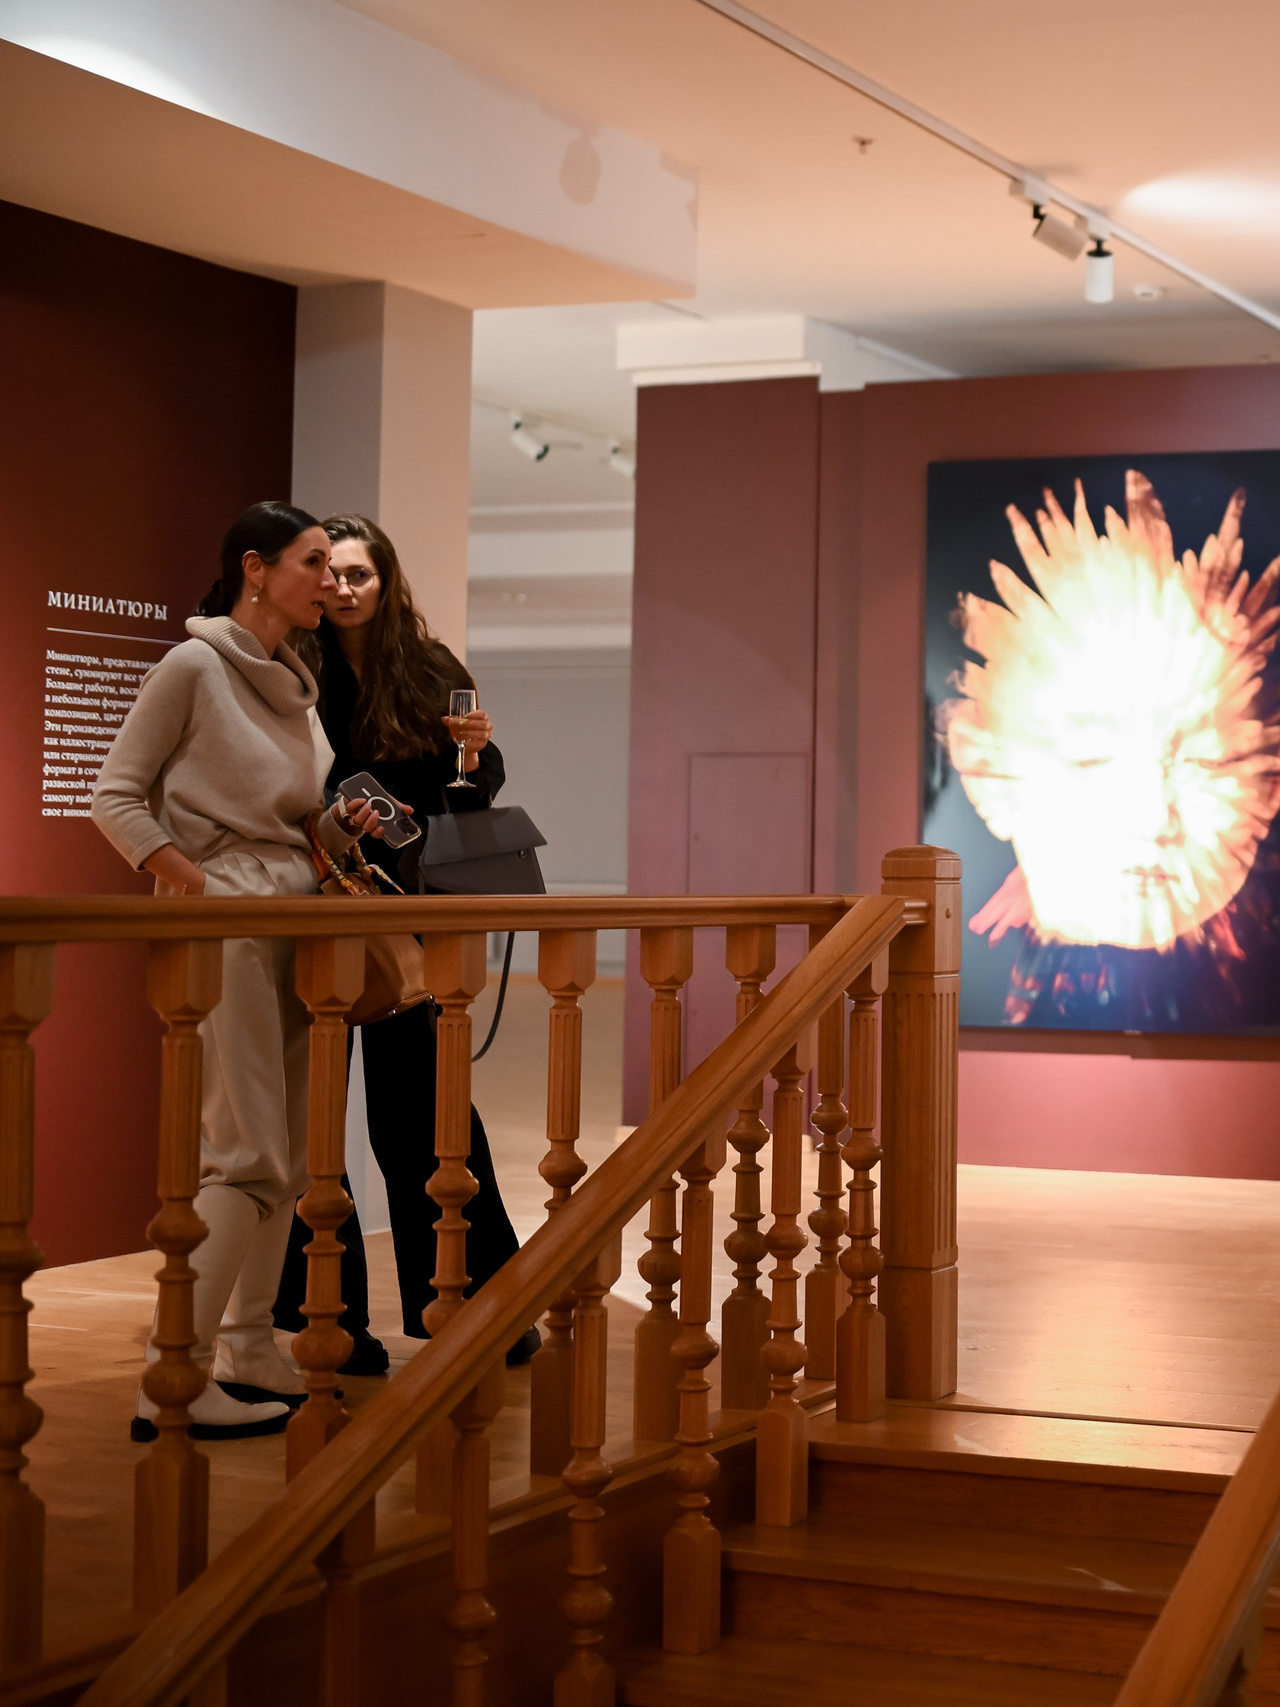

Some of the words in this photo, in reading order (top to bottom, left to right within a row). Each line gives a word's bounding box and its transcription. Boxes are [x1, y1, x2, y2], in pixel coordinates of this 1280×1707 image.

[47, 590, 168, 621] МИНИАТЮРЫ
[46, 649, 102, 667] Миниатюры,
[45, 665, 73, 677] стене,
[46, 678, 84, 691] Большие
[84, 683, 118, 694] работы,
[52, 694, 101, 706] небольшом
[44, 708, 103, 721] композицию,
[103, 712, 124, 723] цвет
[44, 720, 61, 731] Эти
[43, 737, 59, 746] как
[43, 751, 60, 760] или
[43, 763, 77, 776] формат
[42, 778, 86, 790] развеской
[42, 794, 75, 805] самому
[42, 808, 62, 817] свое
